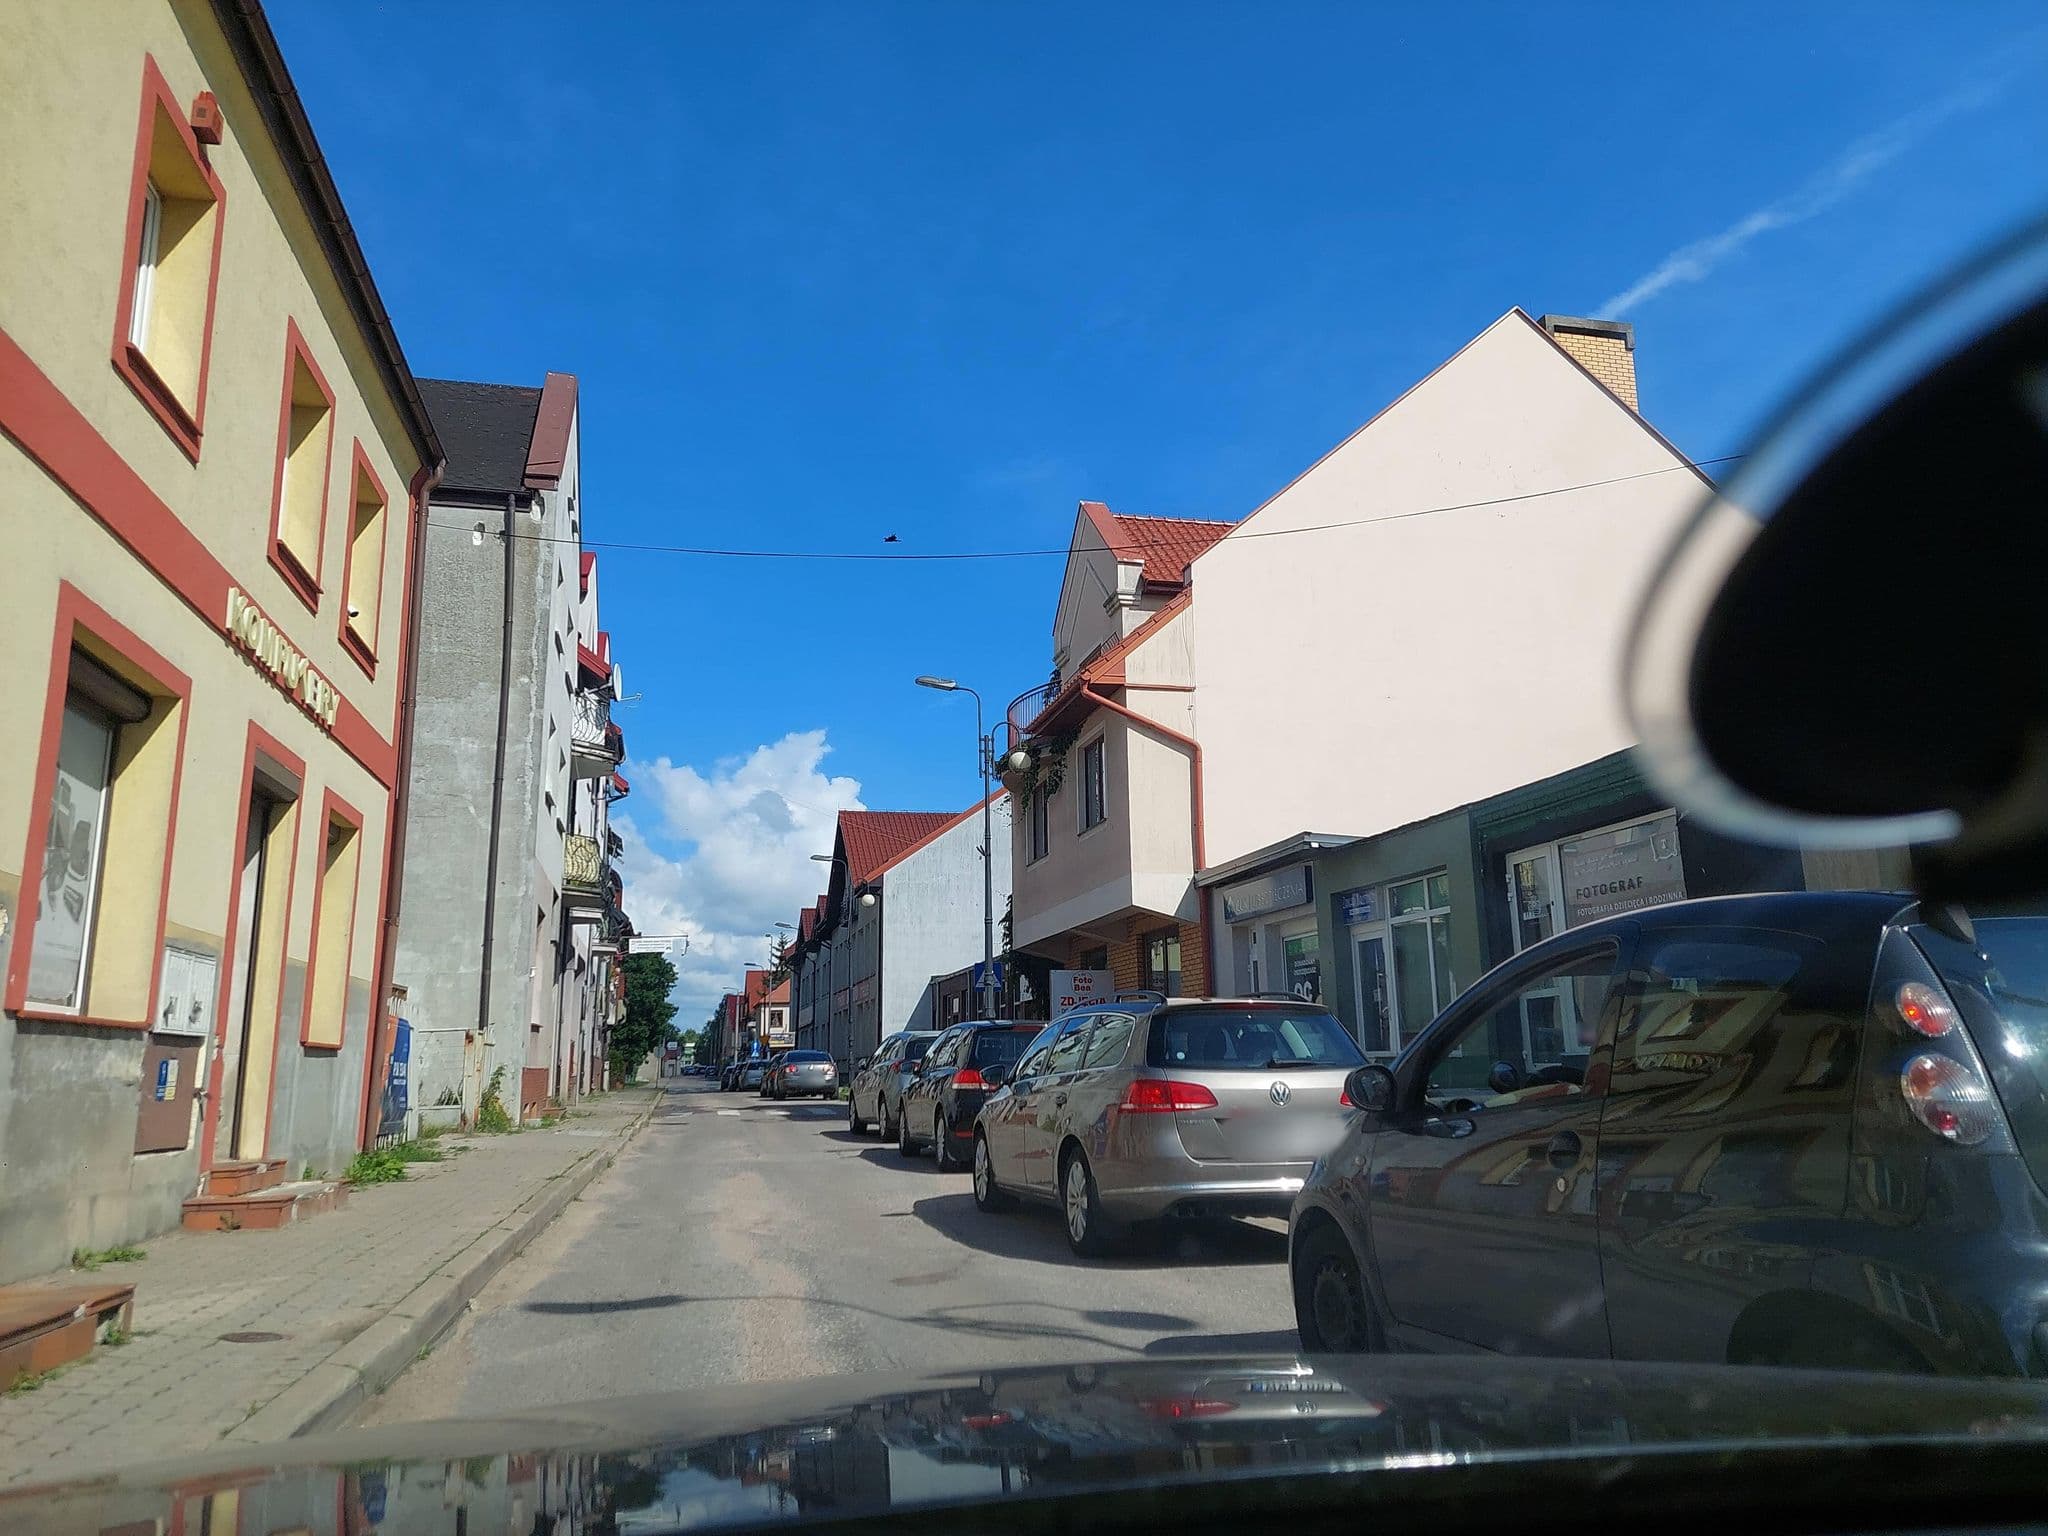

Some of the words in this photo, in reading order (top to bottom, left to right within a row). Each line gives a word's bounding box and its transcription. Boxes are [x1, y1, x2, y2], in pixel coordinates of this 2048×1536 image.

[225, 587, 340, 726] KOMPUTERY
[1576, 877, 1642, 900] FOTOGRAF
[1577, 905, 1614, 918] FOTOGRAFIA
[1648, 891, 1682, 906] RODZINNA
[1073, 976, 1093, 984] Foto
